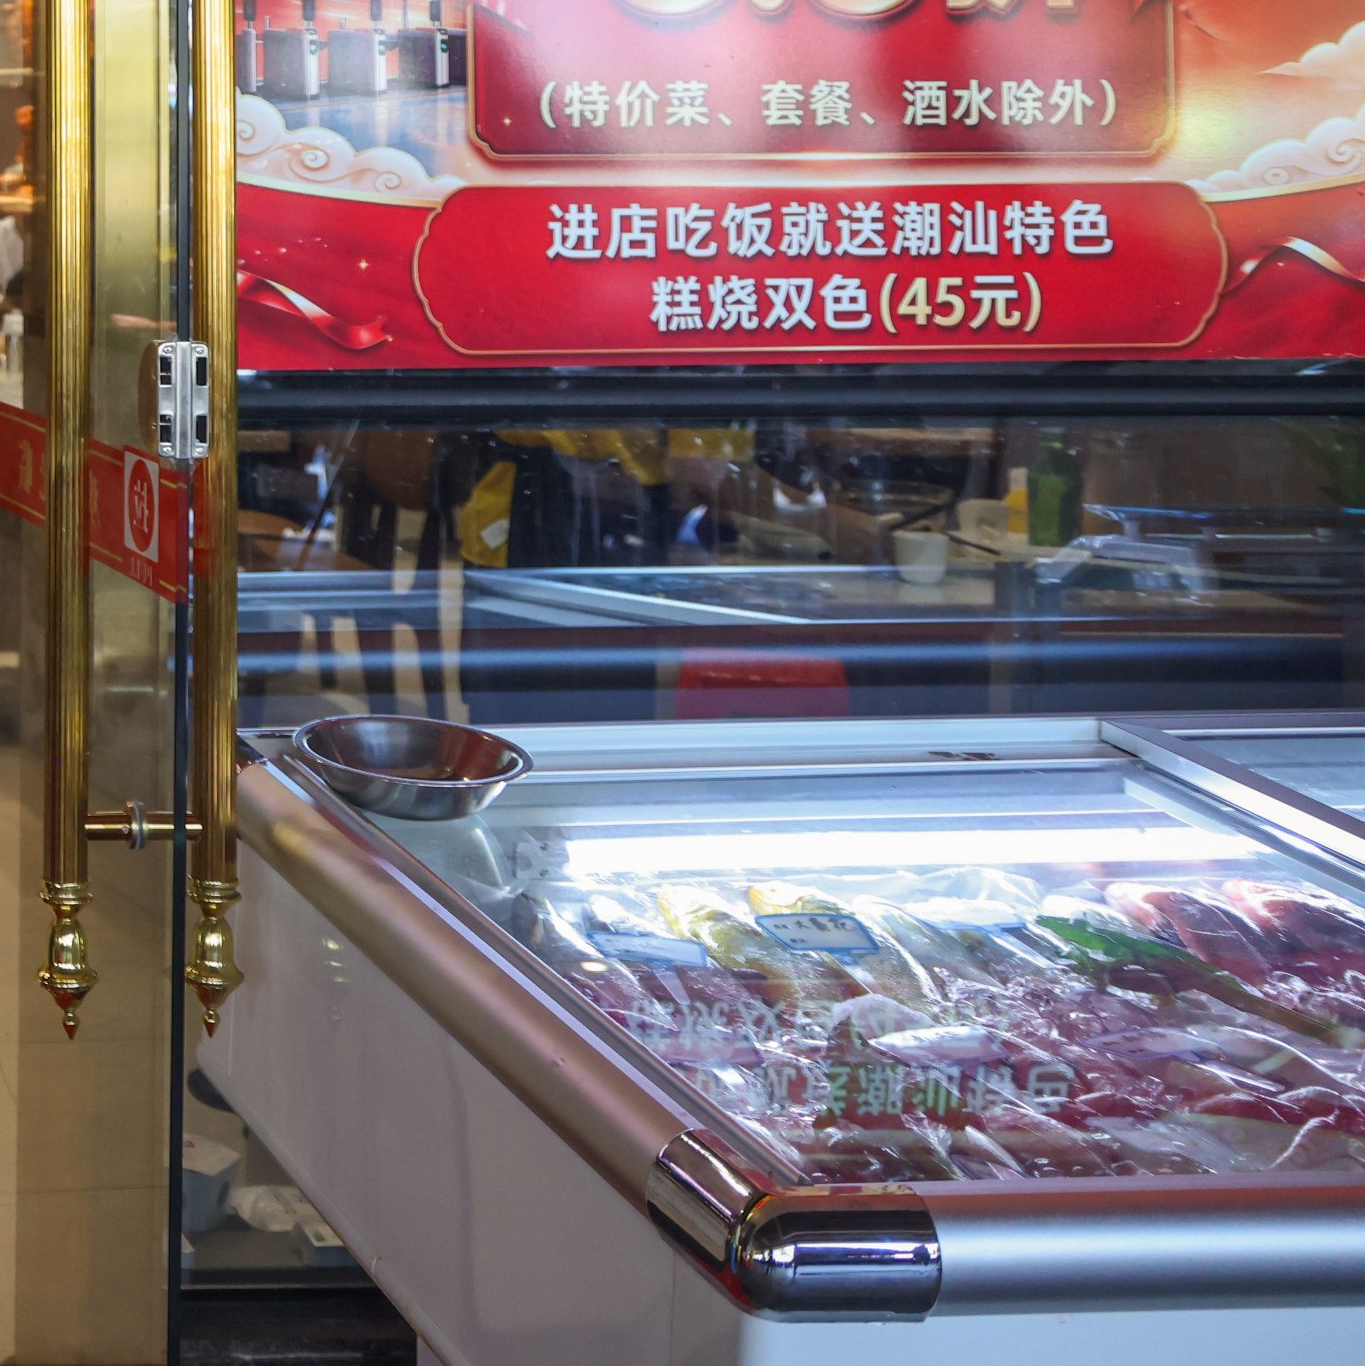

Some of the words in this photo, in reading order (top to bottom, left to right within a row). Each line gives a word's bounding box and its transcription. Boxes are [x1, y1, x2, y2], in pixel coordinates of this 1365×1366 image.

[540, 75, 1119, 131] (特价菜、套餐、酒水除外)
[545, 200, 1114, 263] 进店吃饭就送潮汕特色
[650, 269, 1043, 335] 糕烧双色(45元)
